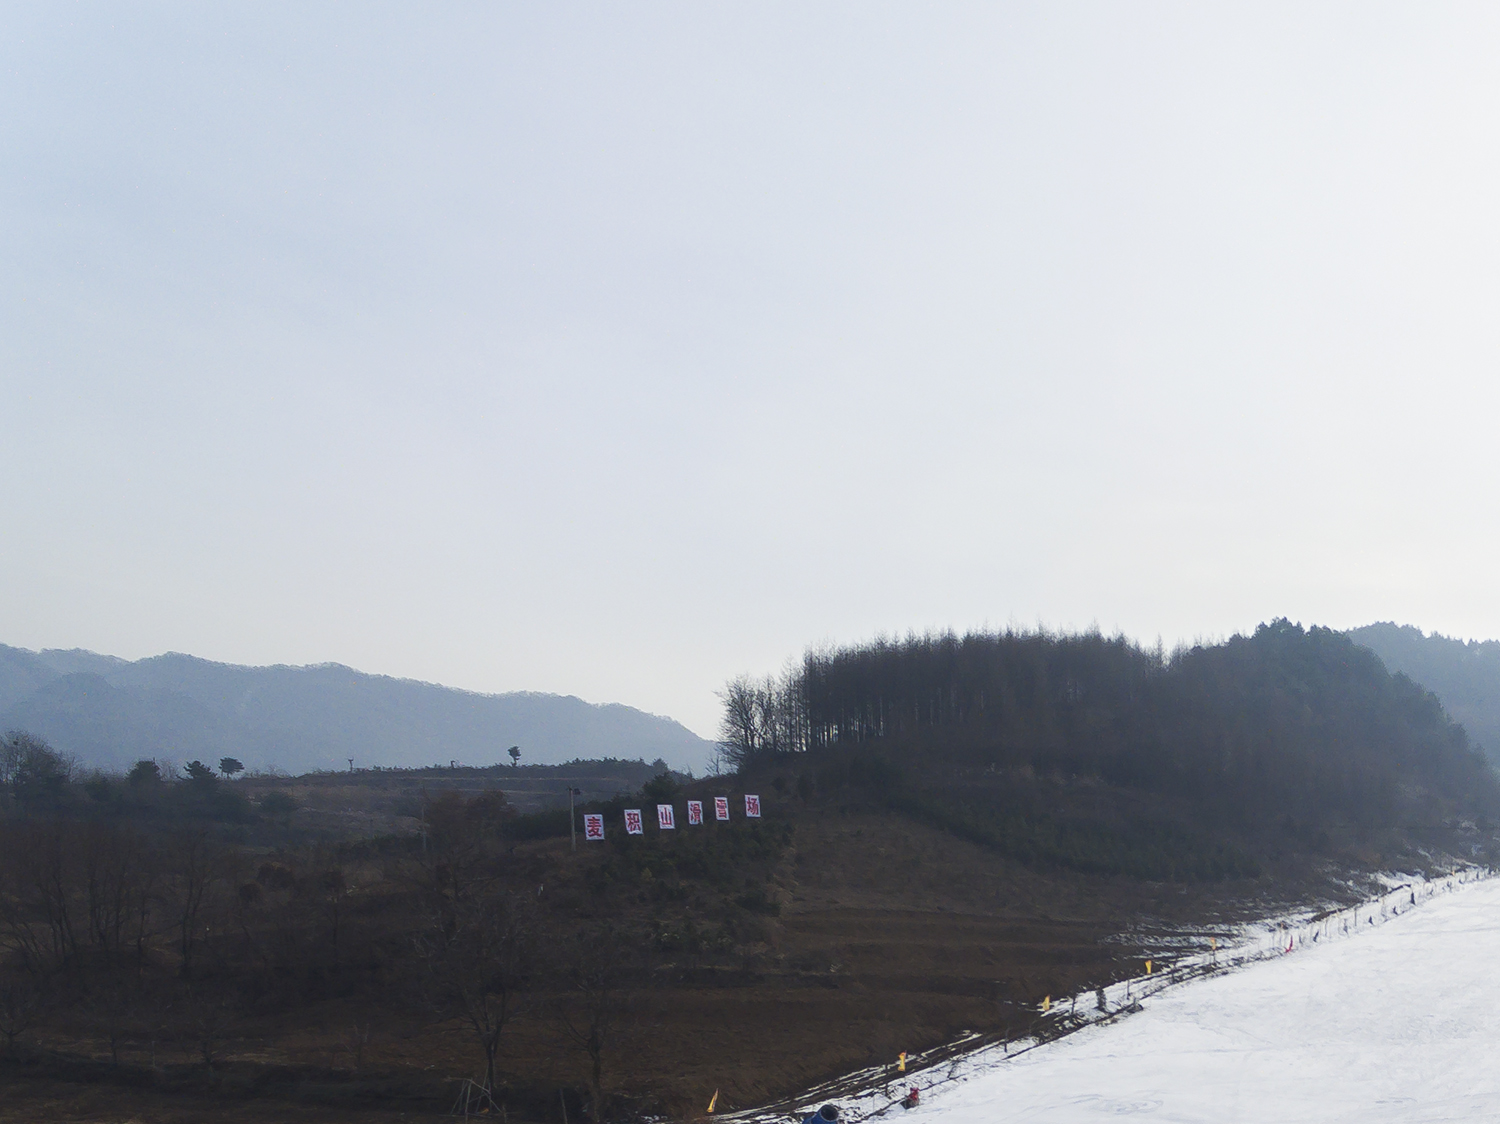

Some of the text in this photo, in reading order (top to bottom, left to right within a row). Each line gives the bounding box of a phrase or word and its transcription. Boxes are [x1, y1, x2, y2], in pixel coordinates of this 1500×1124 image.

[587, 797, 759, 837] 麦积山滑雪场
